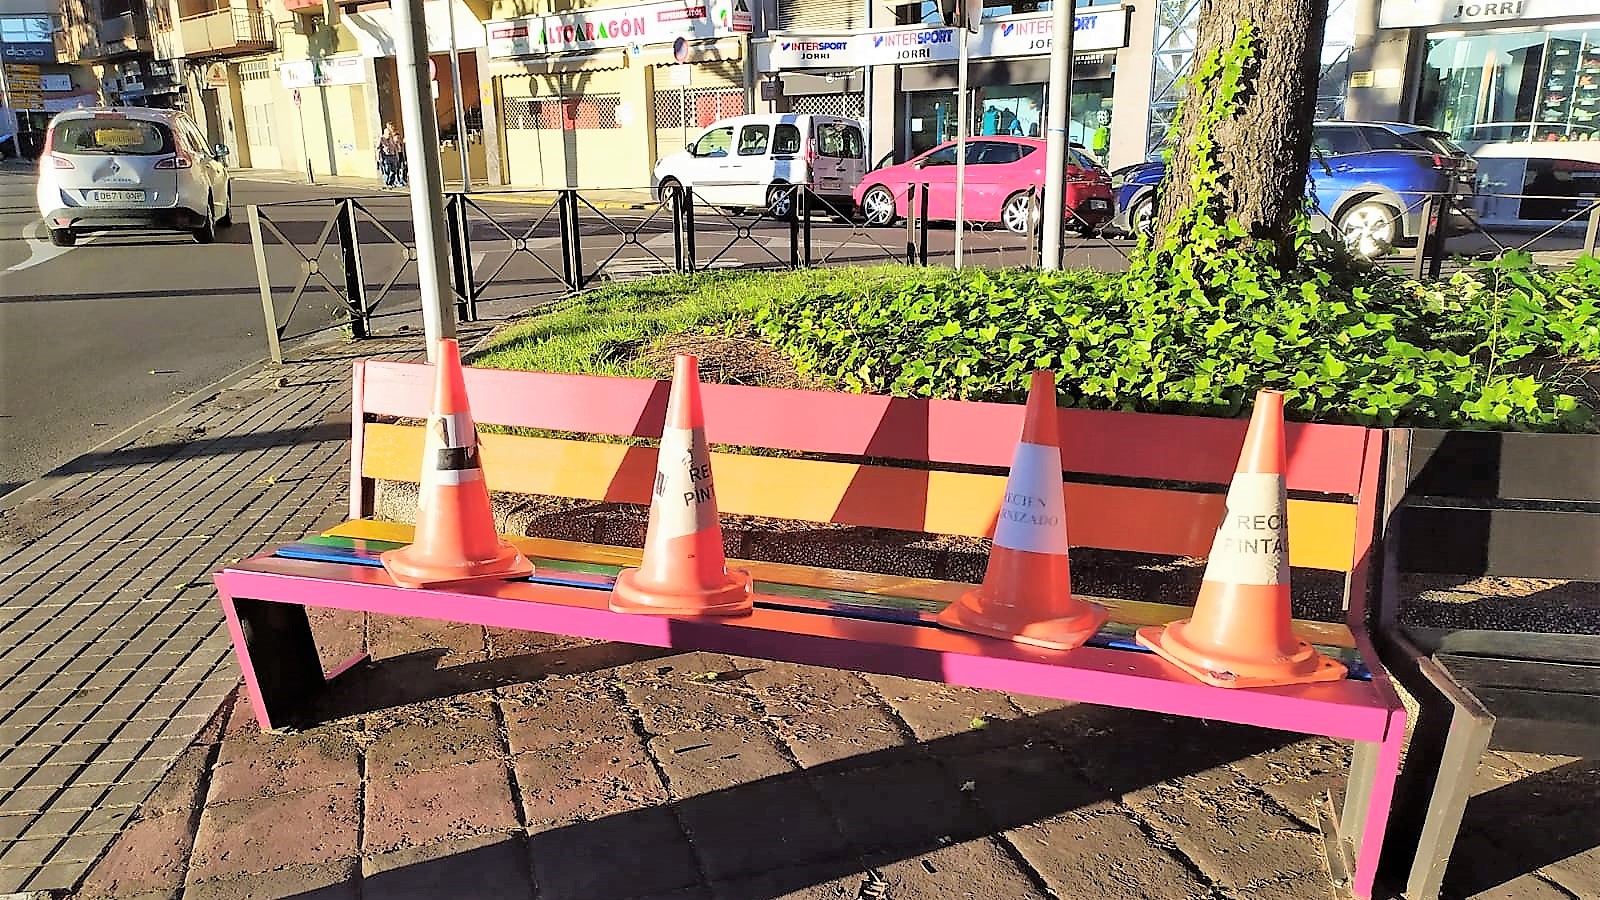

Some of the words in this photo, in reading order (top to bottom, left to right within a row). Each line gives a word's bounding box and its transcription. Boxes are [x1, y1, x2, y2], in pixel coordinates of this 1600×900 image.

[1453, 1, 1523, 18] JORRI
[1015, 15, 1098, 36] INTERORT
[791, 42, 847, 51] INTERSPORT
[885, 29, 953, 47] INTERSPORT
[897, 48, 930, 59] JORRI
